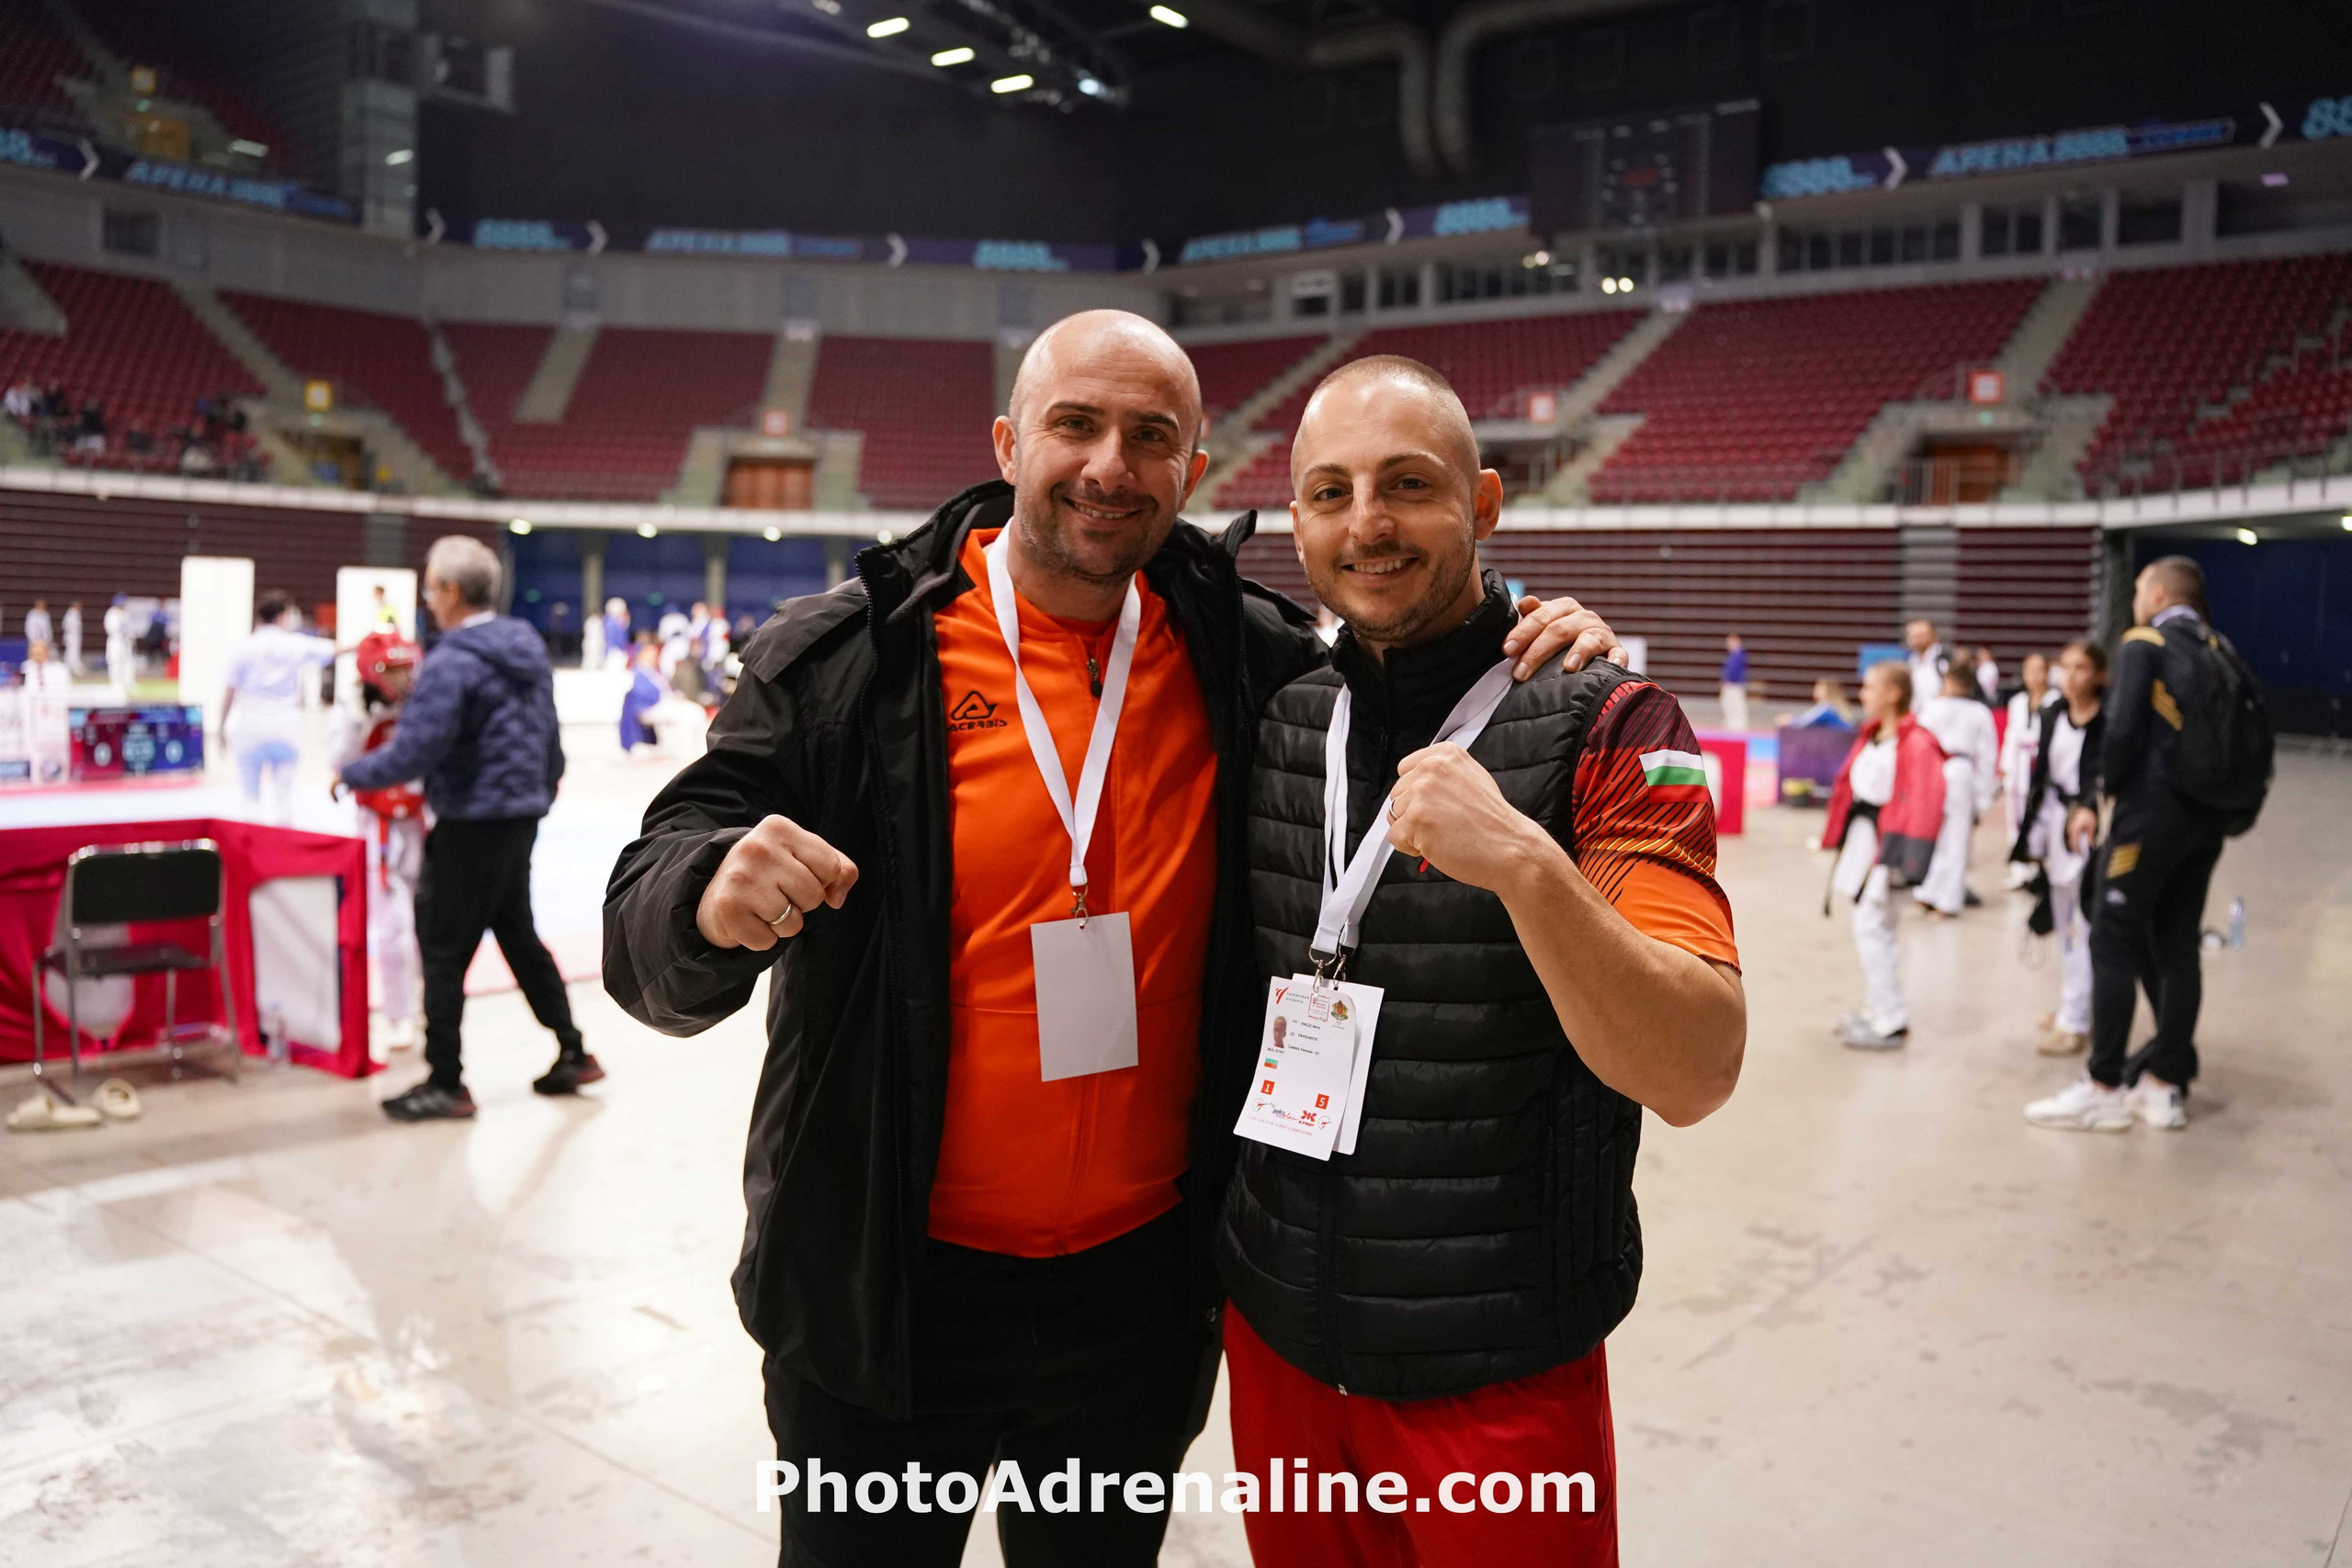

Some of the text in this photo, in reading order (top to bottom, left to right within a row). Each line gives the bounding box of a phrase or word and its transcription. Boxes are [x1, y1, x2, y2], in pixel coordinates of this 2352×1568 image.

[946, 719, 1008, 732] ACERBIS
[1264, 1083, 1271, 1093] 1
[1318, 1097, 1326, 1107] 5
